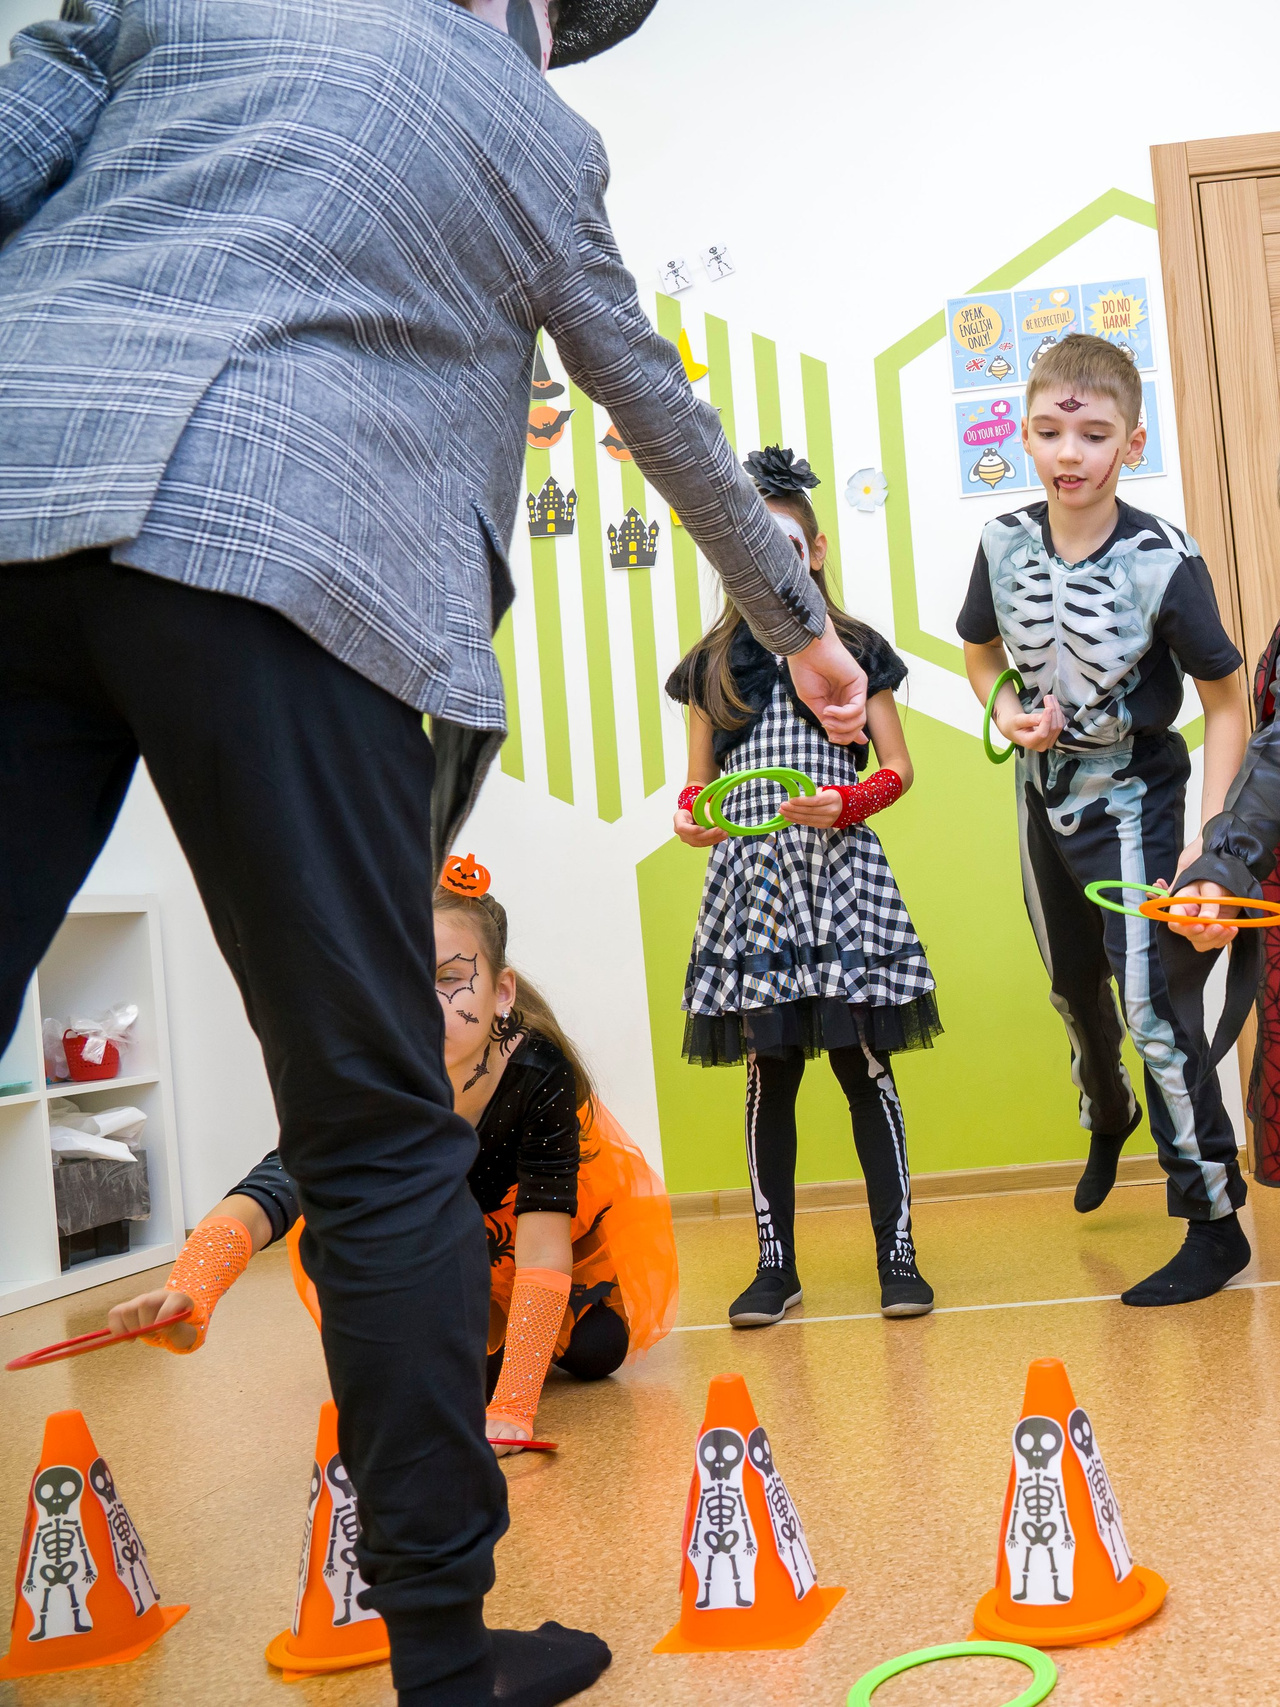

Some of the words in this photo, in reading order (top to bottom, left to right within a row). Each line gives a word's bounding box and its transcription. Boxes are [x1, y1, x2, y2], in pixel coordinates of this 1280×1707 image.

[961, 306, 985, 323] SPEAK
[1102, 299, 1115, 314] DO
[1117, 298, 1130, 312] NO
[958, 318, 993, 337] ENGLISH
[1026, 319, 1033, 330] BE
[1034, 310, 1070, 328] RESPECTFUL!
[1103, 313, 1131, 329] HARM!
[967, 331, 991, 349] ONLY!
[967, 430, 977, 442] DO
[977, 427, 994, 440] YOUR
[995, 422, 1011, 436] BEST!
